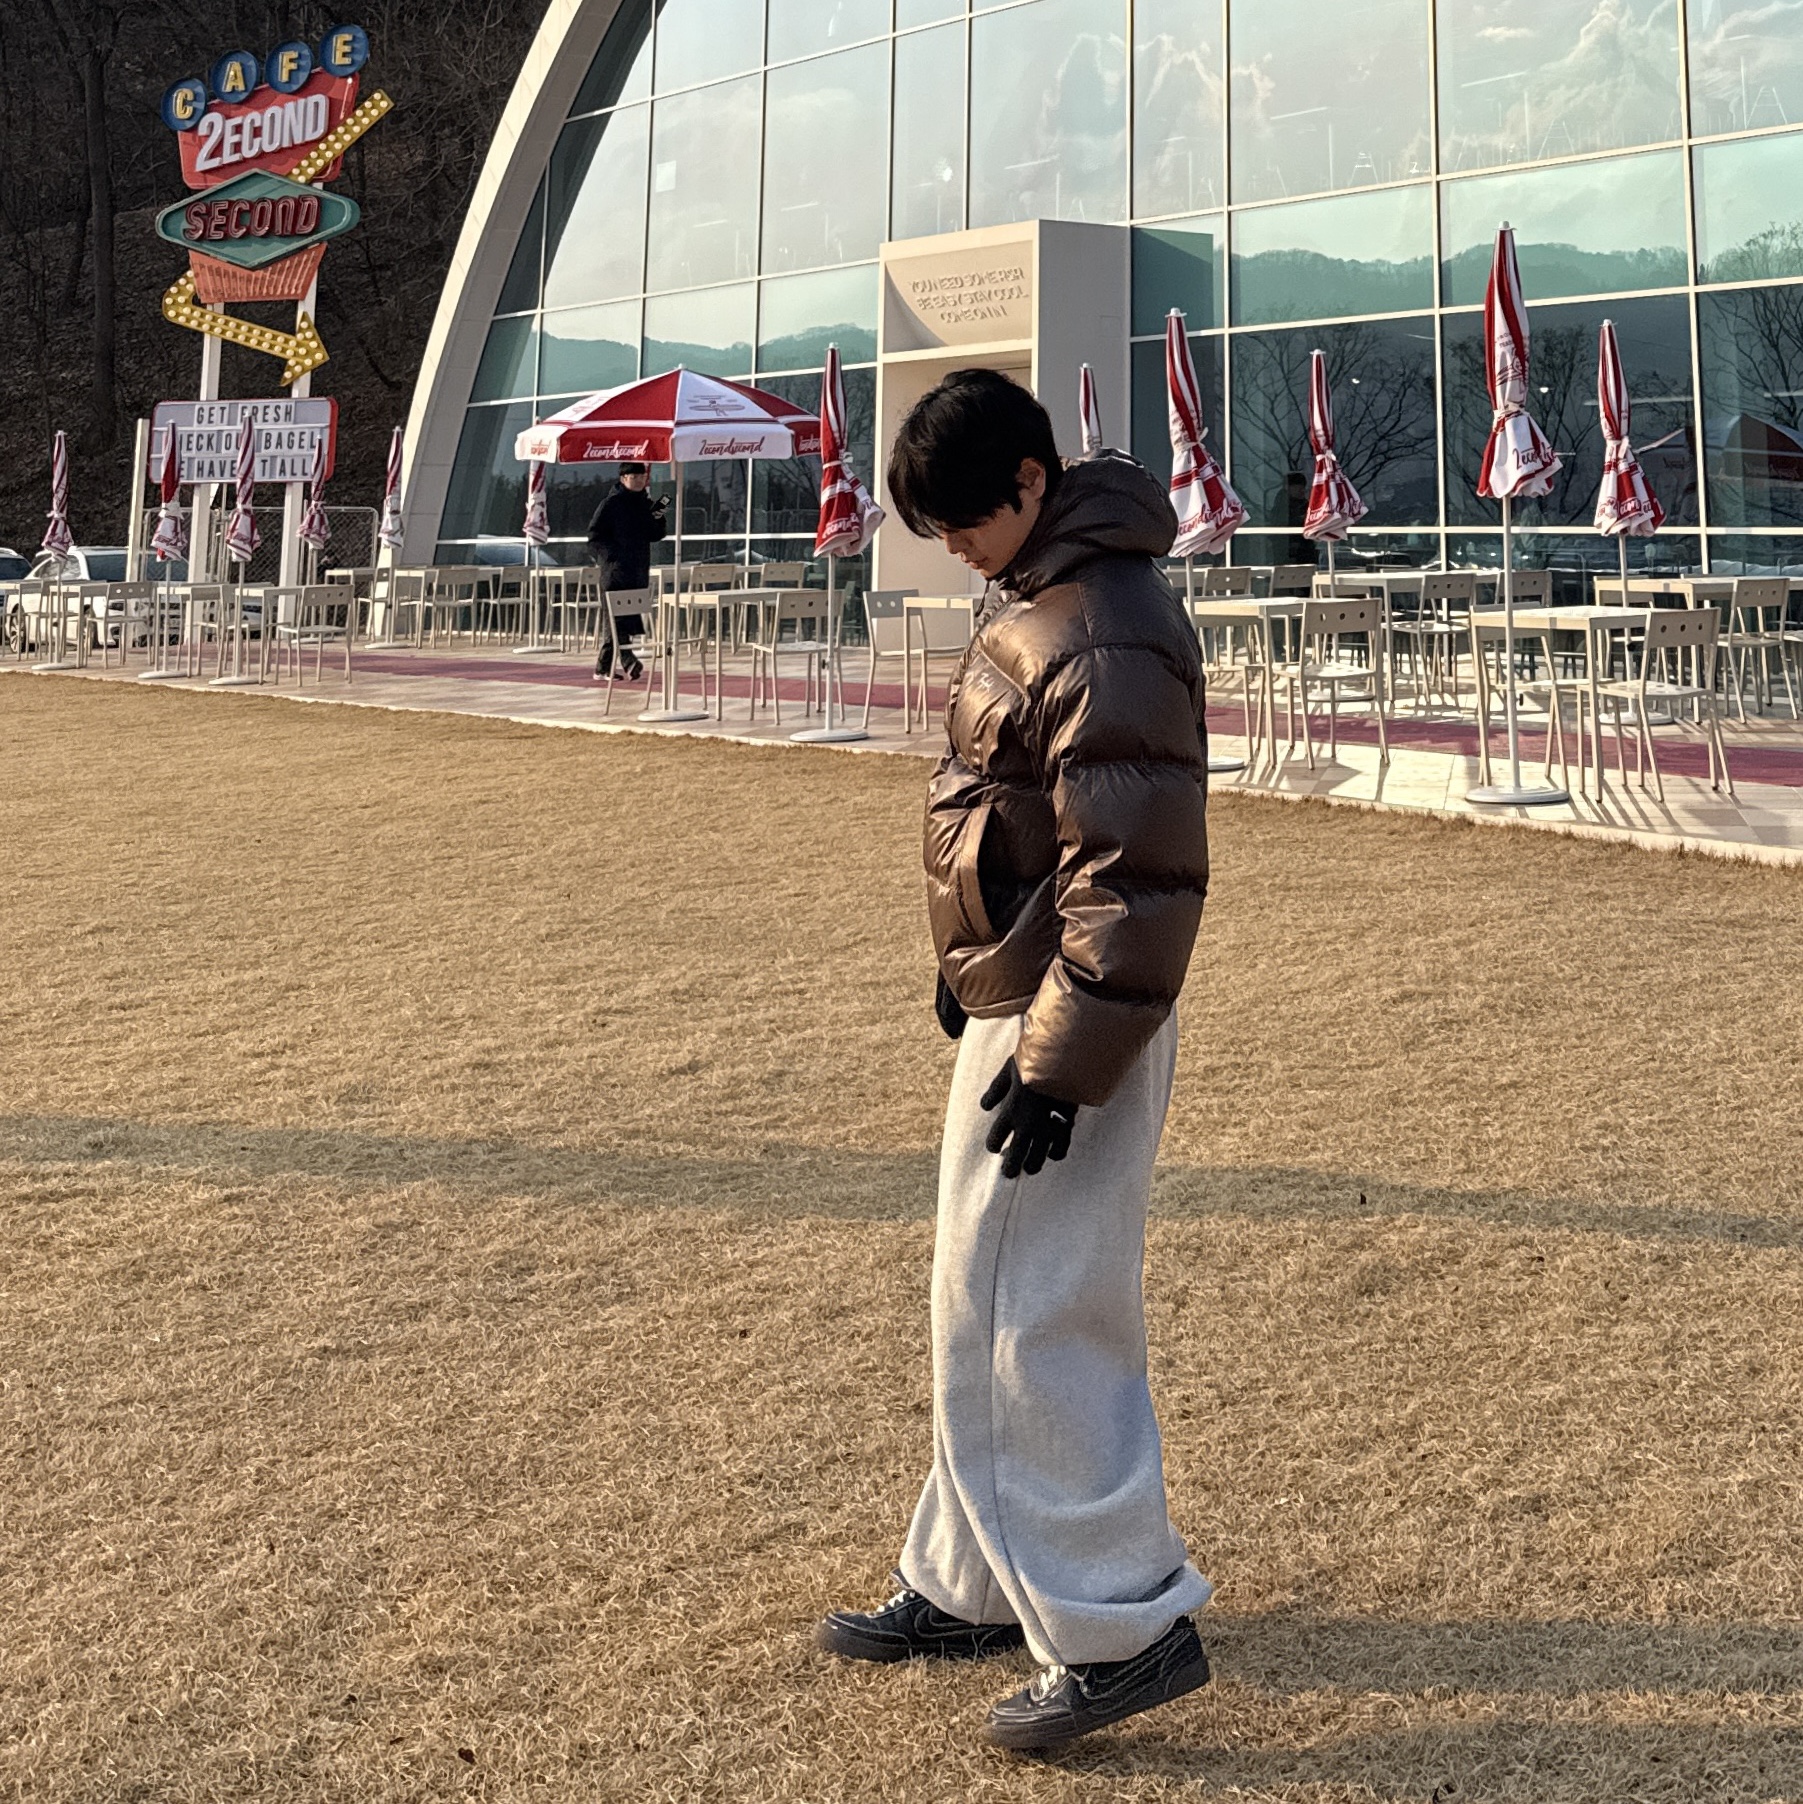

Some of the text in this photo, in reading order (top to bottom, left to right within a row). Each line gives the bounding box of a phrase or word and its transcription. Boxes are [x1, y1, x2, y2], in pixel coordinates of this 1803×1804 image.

[172, 34, 353, 120] CAFE
[195, 93, 330, 172] 2ECOND
[183, 196, 321, 241] SECOND
[908, 278, 932, 293] YOU
[933, 275, 964, 290] NEED
[964, 270, 999, 287] SOME
[963, 289, 992, 304] STAY
[993, 285, 1029, 301] COOL
[940, 308, 974, 323] COME
[196, 404, 293, 425] GET FRESH
[196, 459, 238, 478] HAVE
[278, 458, 309, 477] ALL
